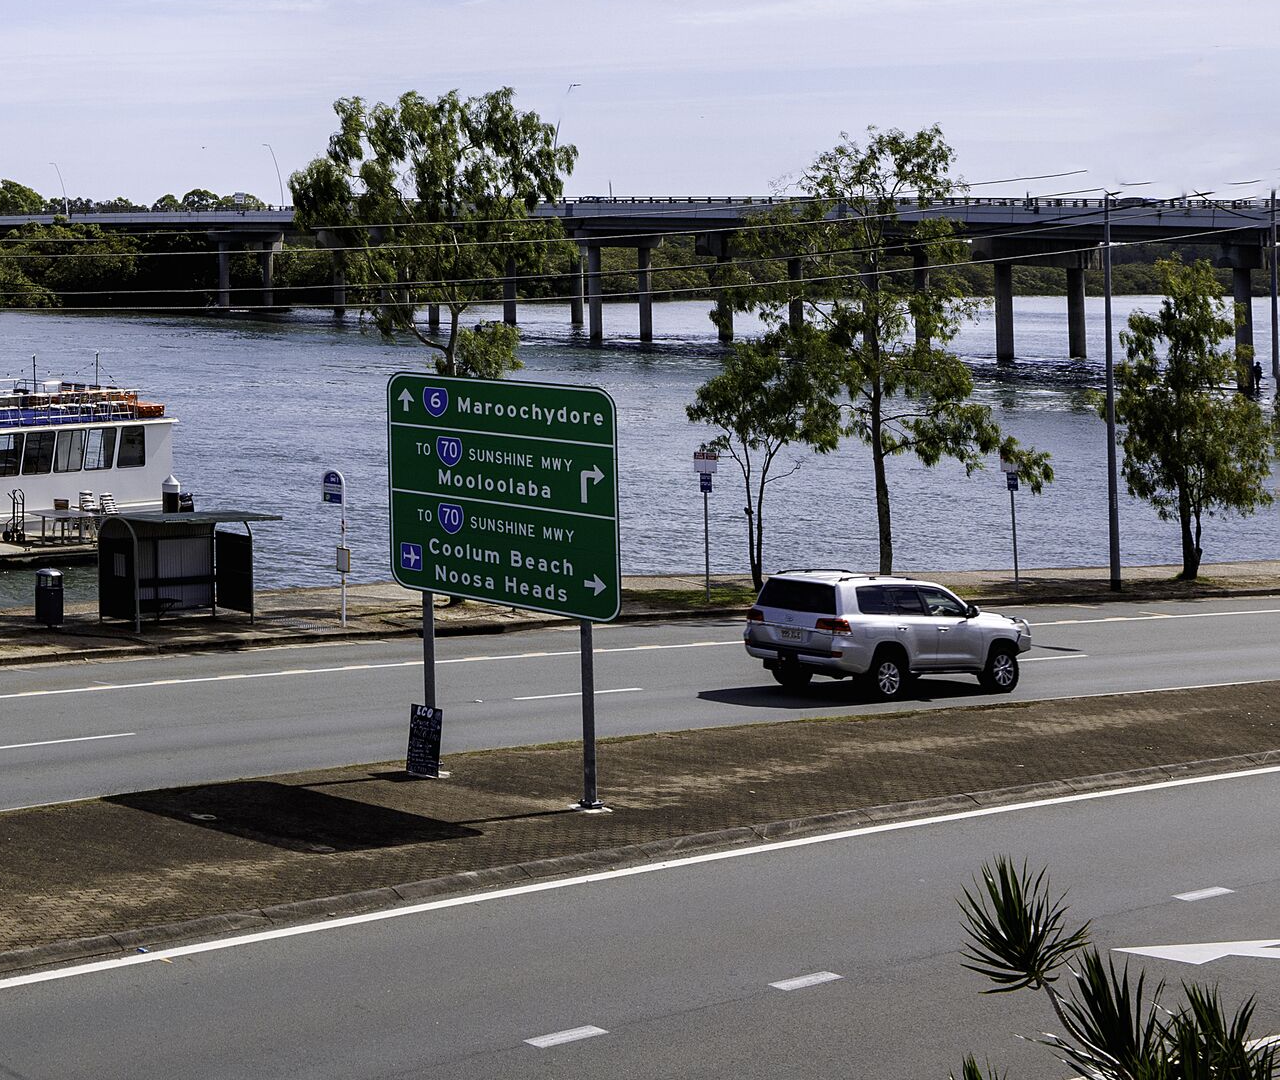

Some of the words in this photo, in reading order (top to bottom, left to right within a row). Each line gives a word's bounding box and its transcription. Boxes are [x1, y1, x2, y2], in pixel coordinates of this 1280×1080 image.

[430, 392, 441, 408] 6
[457, 396, 604, 426] Maroochydore
[416, 442, 431, 456] TO
[441, 441, 458, 459] 70
[468, 448, 534, 468] SUNSHINE
[541, 456, 573, 472] MWY
[438, 469, 552, 499] Mooloolaba
[417, 509, 432, 522] TO
[443, 508, 459, 526] 70
[470, 517, 536, 538] SUNSHINE
[543, 526, 575, 543] MWY
[429, 538, 500, 564] Coolum
[510, 551, 574, 576] Beach
[435, 566, 495, 590] Noosa
[505, 577, 568, 602] Heads
[416, 706, 433, 718] ECO
